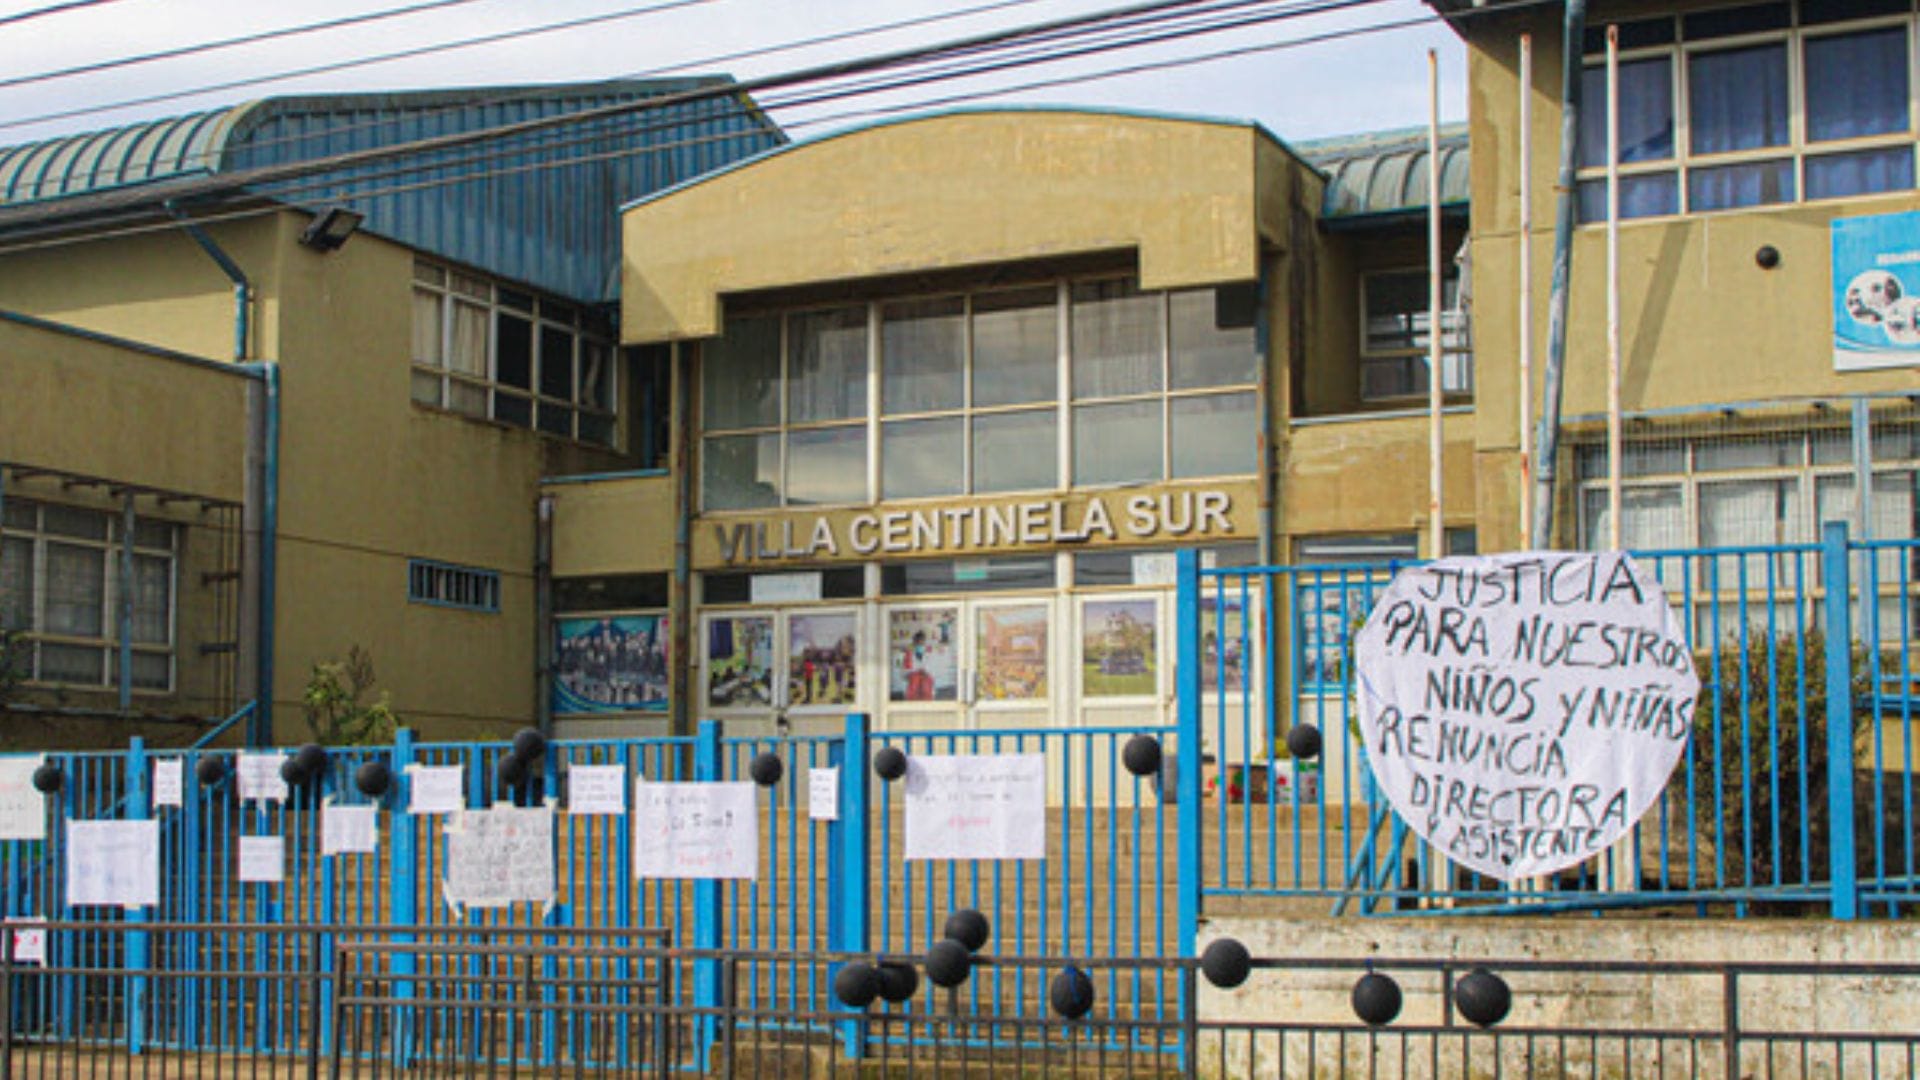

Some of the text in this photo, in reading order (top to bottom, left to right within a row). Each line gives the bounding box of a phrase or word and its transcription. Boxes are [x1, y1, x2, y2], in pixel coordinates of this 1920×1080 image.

[715, 490, 1234, 564] VILLA CENTINELA SUR
[1383, 600, 1690, 675] PARA NUESTROS
